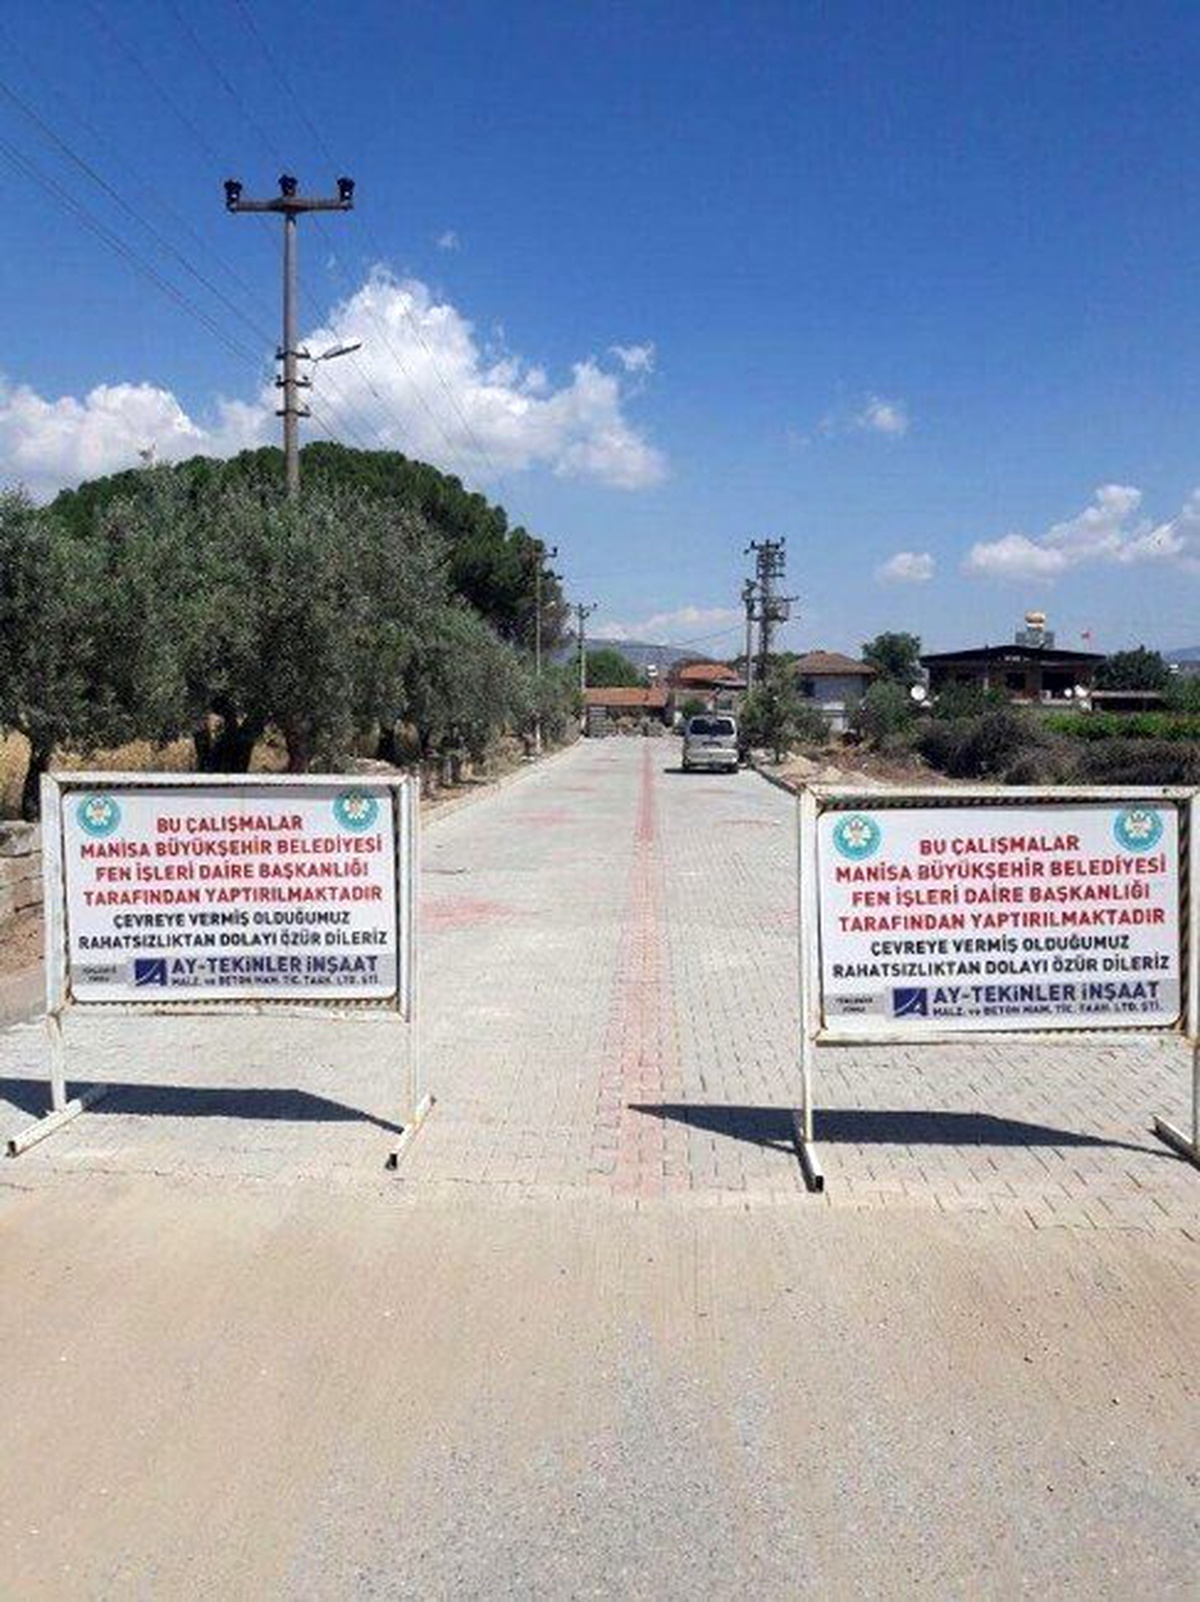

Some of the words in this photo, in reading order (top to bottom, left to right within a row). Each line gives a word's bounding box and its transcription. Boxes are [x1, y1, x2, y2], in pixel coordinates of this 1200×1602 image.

[157, 818, 180, 833] BU
[186, 815, 303, 833] ÇALIŞMALAR
[81, 839, 149, 859] MANİSA
[156, 835, 271, 858] BÜYÜKŞEHİR
[278, 834, 382, 854] BELEDİYESİ
[919, 839, 944, 856] BU
[952, 835, 1080, 856] ÇALIŞMALAR
[96, 867, 132, 881] FEN
[137, 861, 193, 883] İŞLERİ
[199, 860, 254, 878] DAİRE
[259, 857, 368, 879] BAŞKANLIĞI
[836, 862, 911, 883] MANİSA
[919, 857, 1044, 880] BÜYÜKŞEHİR
[1051, 853, 1166, 876] BELEDİYESİ
[84, 889, 200, 906] TARAFINDAN
[207, 886, 382, 902] YAPTIRILMAKTADIR
[852, 891, 891, 907] FEN
[896, 884, 959, 908] İŞLERİ
[965, 883, 1024, 903] DAİRE
[1029, 880, 1149, 903] BAŞKANLIĞI
[114, 913, 184, 929] ÇEVREYE
[189, 909, 249, 929] VERMİŞ
[253, 909, 350, 925] OLDUĞUMUZ
[838, 913, 964, 932] TARAFINDAN
[971, 908, 1165, 929] YAPTIRILMAKTADIR
[79, 934, 215, 950] RAHATSIZLIKTAN
[220, 932, 277, 947] DOLAYI
[280, 929, 321, 947] ÖZÜR
[326, 928, 387, 945] DİLERİZ
[871, 938, 948, 957] ÇEVREYE
[953, 934, 1018, 955] VERMİŞ
[1022, 934, 1129, 951] OLDUĞUMUZ
[833, 961, 981, 978] RAHATSIZLIKTAN
[986, 959, 1048, 975] DOLAYI
[1052, 956, 1097, 973] ÖZÜR
[1103, 954, 1170, 972] DİLERİZ
